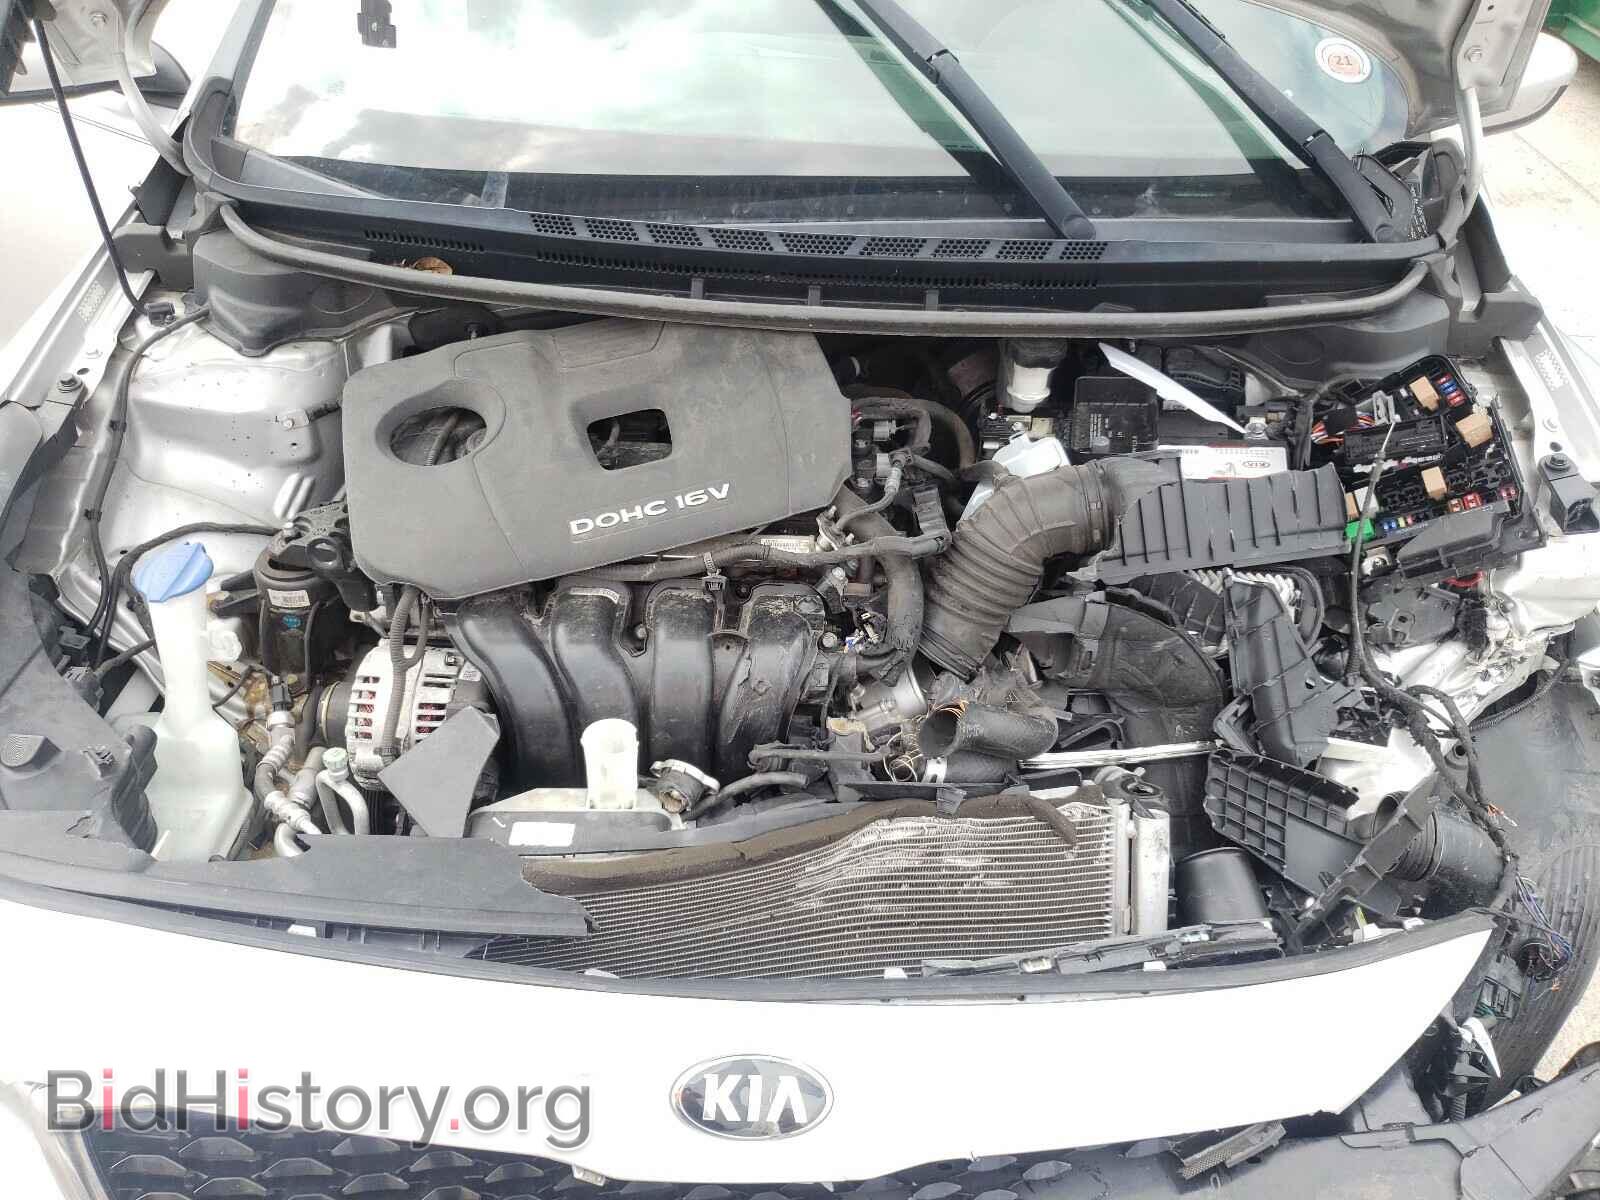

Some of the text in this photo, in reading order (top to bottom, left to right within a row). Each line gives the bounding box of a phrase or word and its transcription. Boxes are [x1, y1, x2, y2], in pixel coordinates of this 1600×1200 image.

[569, 483, 730, 535] DOHC 16V
[702, 1072, 808, 1125] KIA
